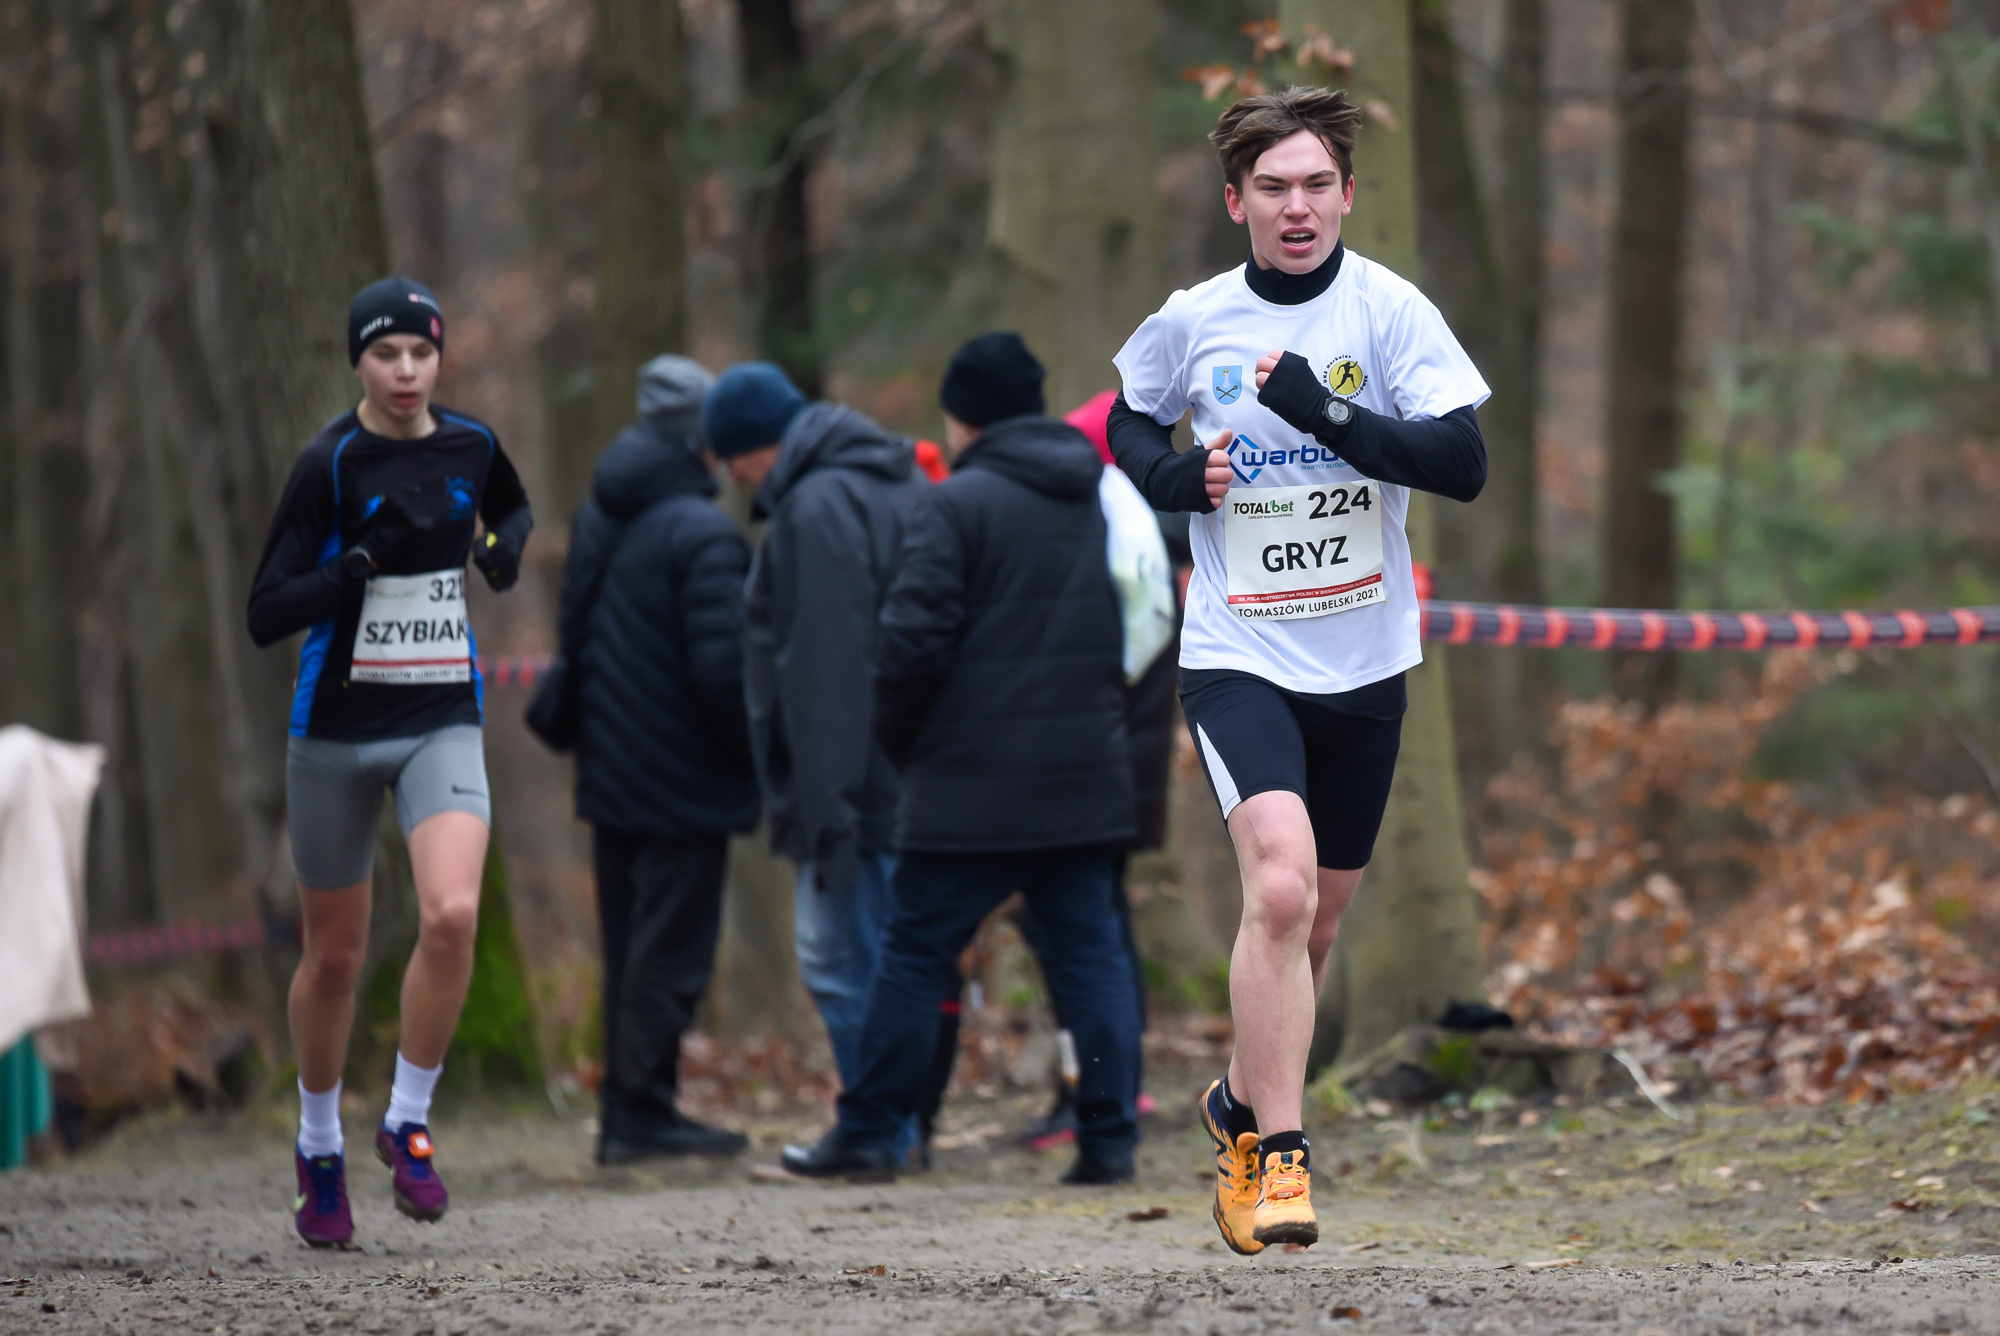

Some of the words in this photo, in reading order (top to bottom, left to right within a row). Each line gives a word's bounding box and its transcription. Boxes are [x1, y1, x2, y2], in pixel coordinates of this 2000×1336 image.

[1233, 499, 1294, 515] TOTALbet
[1308, 485, 1372, 520] 224
[1261, 535, 1349, 573] GRYZ
[1238, 602, 1305, 618] TOMASZÓW
[1308, 596, 1353, 612] LUBELSKI
[1356, 587, 1379, 602] 2021
